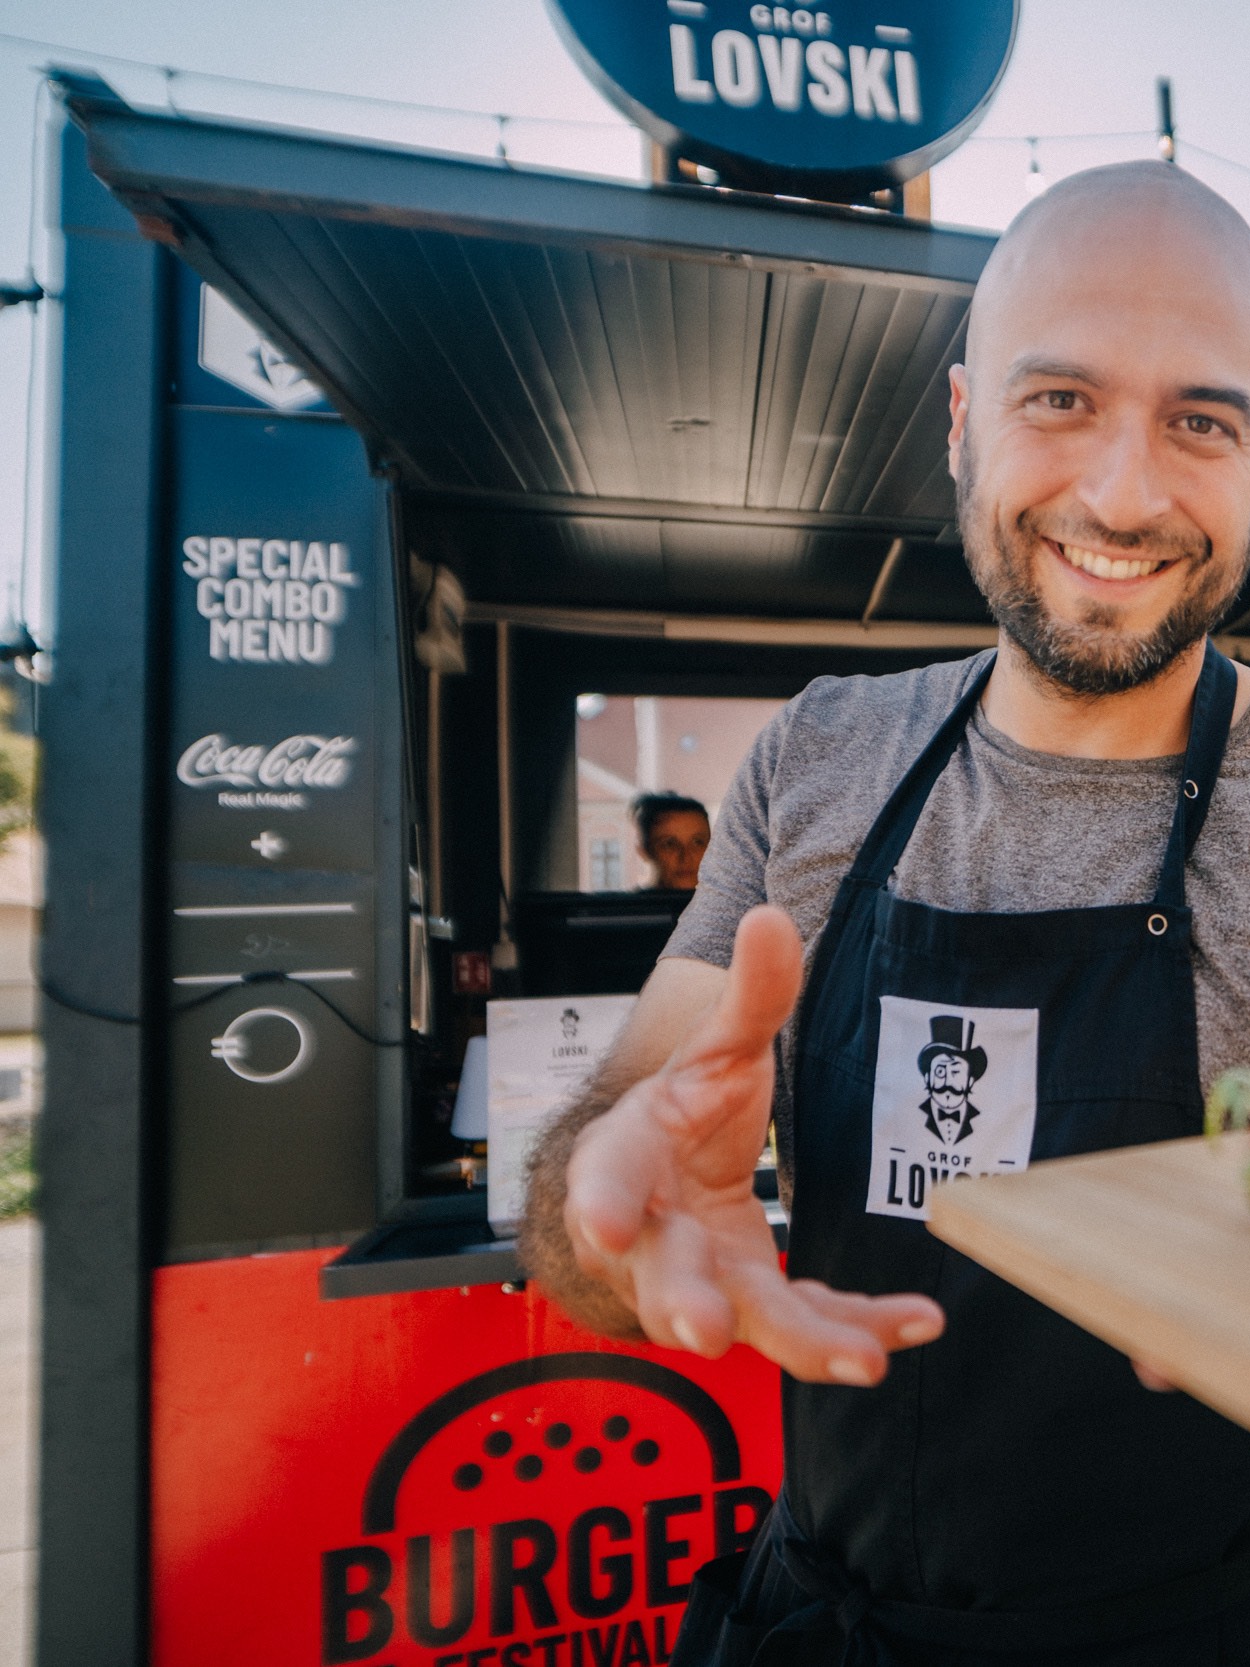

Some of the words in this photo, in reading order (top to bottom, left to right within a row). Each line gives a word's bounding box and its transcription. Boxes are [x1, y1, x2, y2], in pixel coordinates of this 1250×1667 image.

[750, 4, 832, 36] GROF
[668, 23, 922, 124] LOVSKI
[182, 536, 356, 584] SPECIAL
[196, 577, 343, 622] COMBO
[209, 618, 332, 664] MENU
[218, 792, 254, 808] Real
[256, 792, 304, 810] Magic
[552, 1045, 588, 1057] LOVSKI
[928, 1152, 971, 1167] GROF
[321, 1486, 773, 1665] BURGER
[434, 1615, 673, 1667] STIVAL
